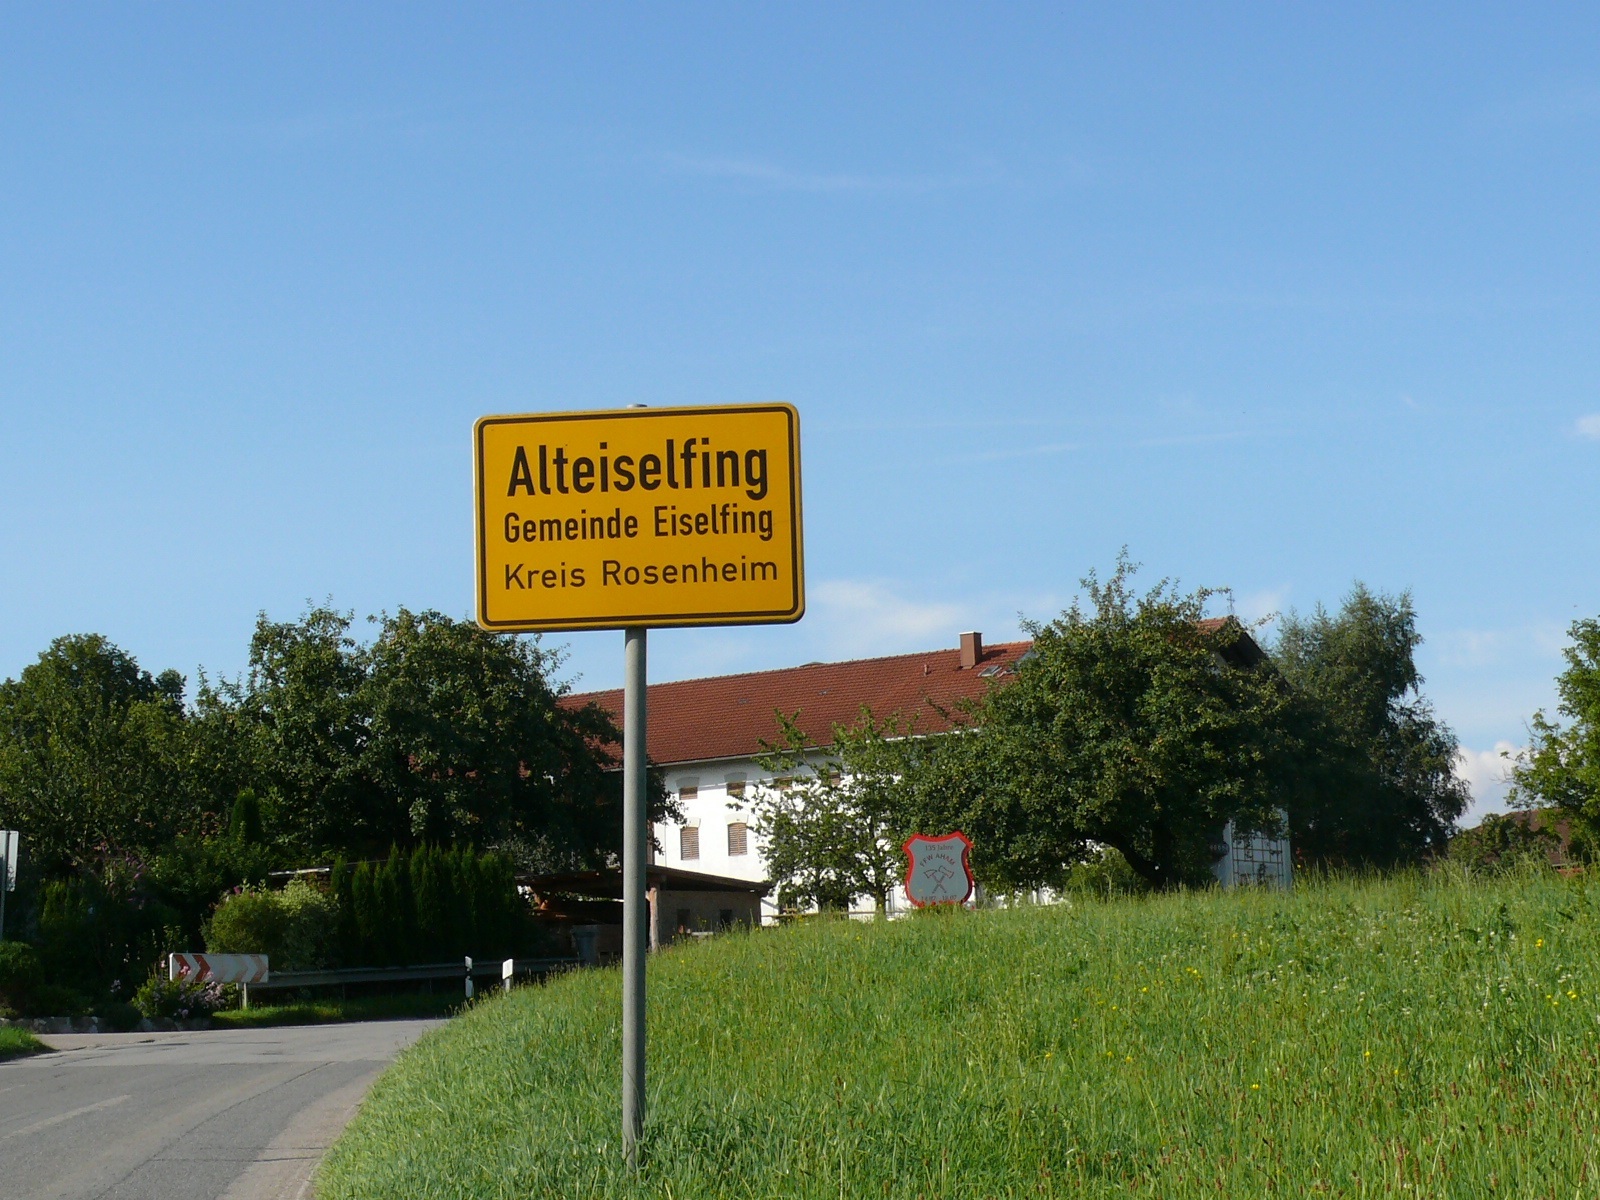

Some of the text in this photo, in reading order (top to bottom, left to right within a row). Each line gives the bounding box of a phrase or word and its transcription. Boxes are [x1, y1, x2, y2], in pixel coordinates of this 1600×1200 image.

[507, 437, 768, 500] Alteiselfing
[504, 503, 773, 543] Gemeinde Eiselfing
[505, 555, 778, 590] Kreis Rosenheim
[935, 853, 955, 865] AHAM
